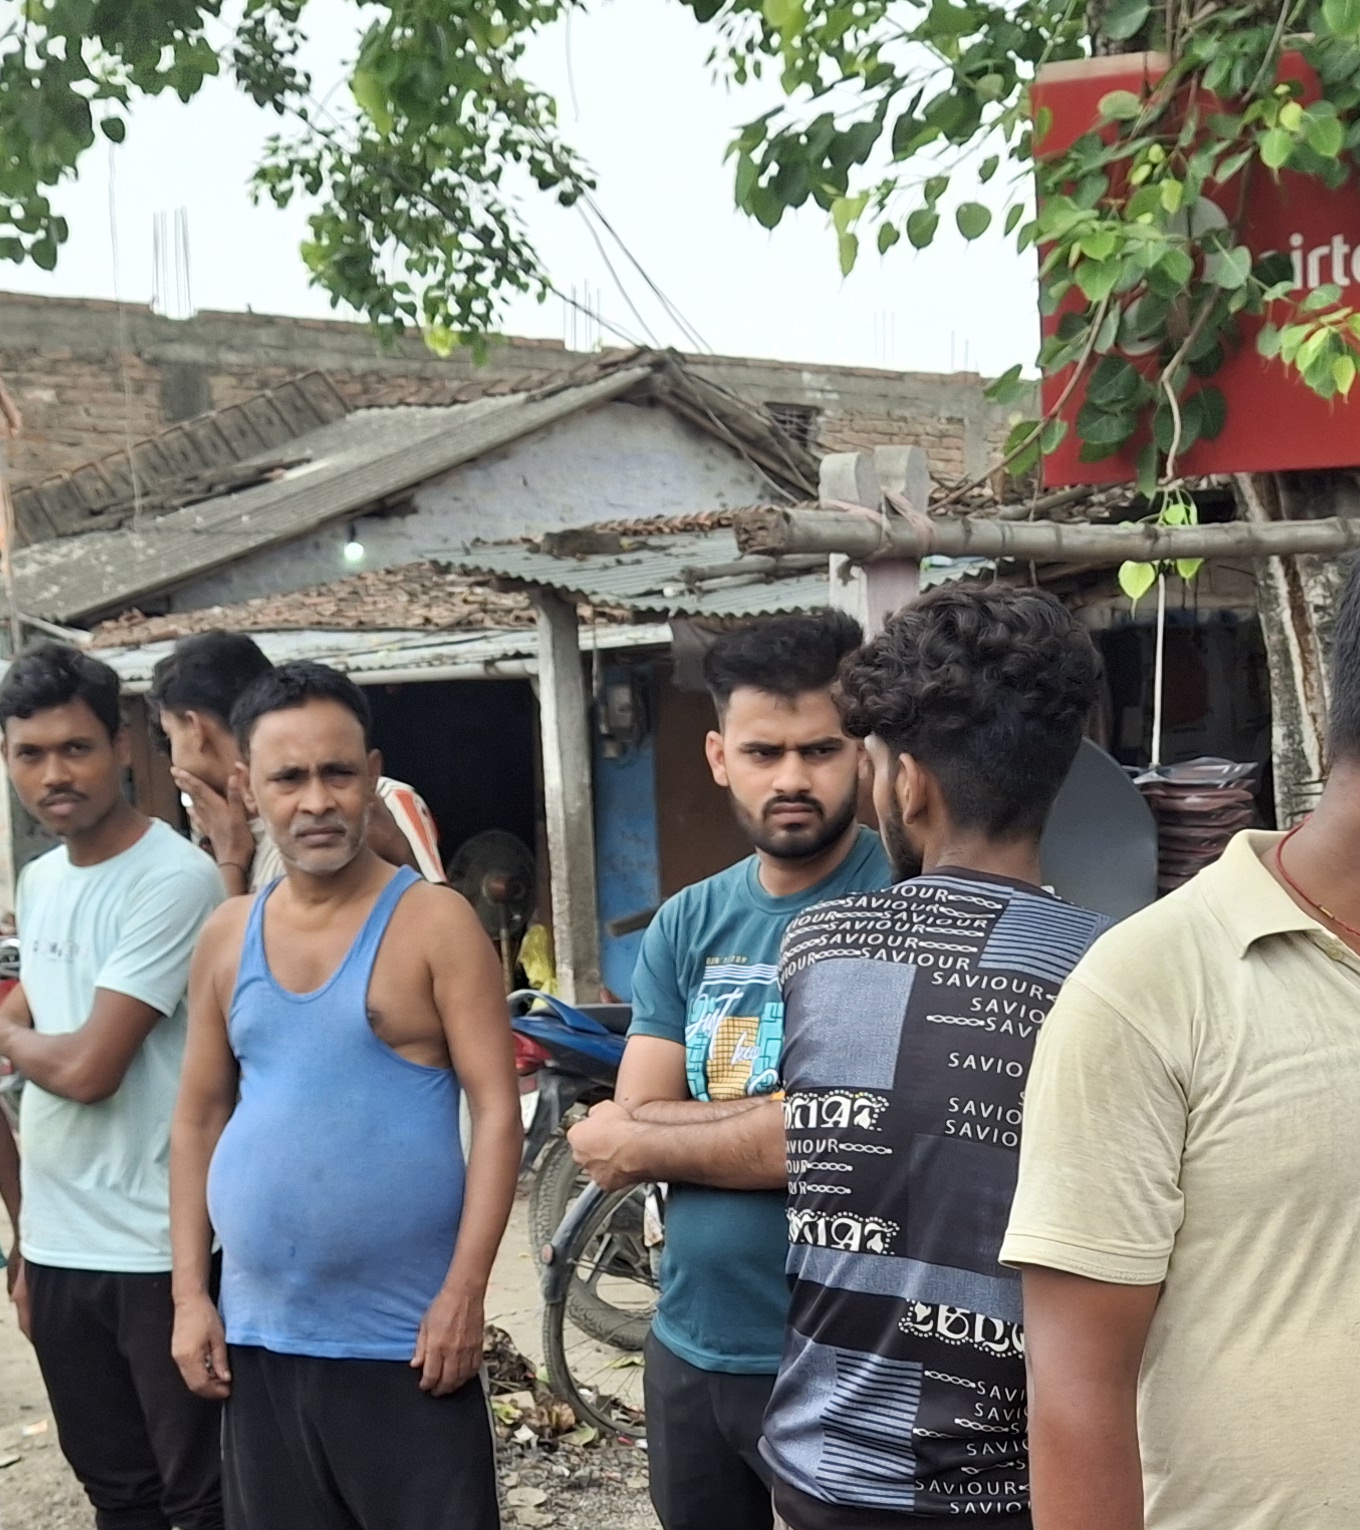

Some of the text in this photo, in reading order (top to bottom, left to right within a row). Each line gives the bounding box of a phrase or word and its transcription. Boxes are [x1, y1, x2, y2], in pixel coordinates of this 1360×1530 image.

[891, 885, 949, 902] IOUR
[843, 896, 939, 914] SAVIOUR
[826, 920, 926, 935] SAVIOUR
[881, 910, 988, 929] SAVIOUR
[817, 932, 919, 950] SAVIOUR
[859, 947, 971, 971] SAVIOUR
[931, 970, 1044, 1001] SAVIOUR
[969, 997, 1045, 1024] SAVIO
[948, 1052, 1023, 1078] SAVIO
[948, 1097, 1022, 1125] SAVIO
[944, 1119, 1018, 1147] SAVIO
[976, 1380, 1025, 1402] SAVI
[973, 1402, 1029, 1422] SAVI
[966, 1439, 1029, 1456] SAVI
[915, 1479, 1017, 1496] SAVIOUR
[950, 1501, 1031, 1515] SAVIO
